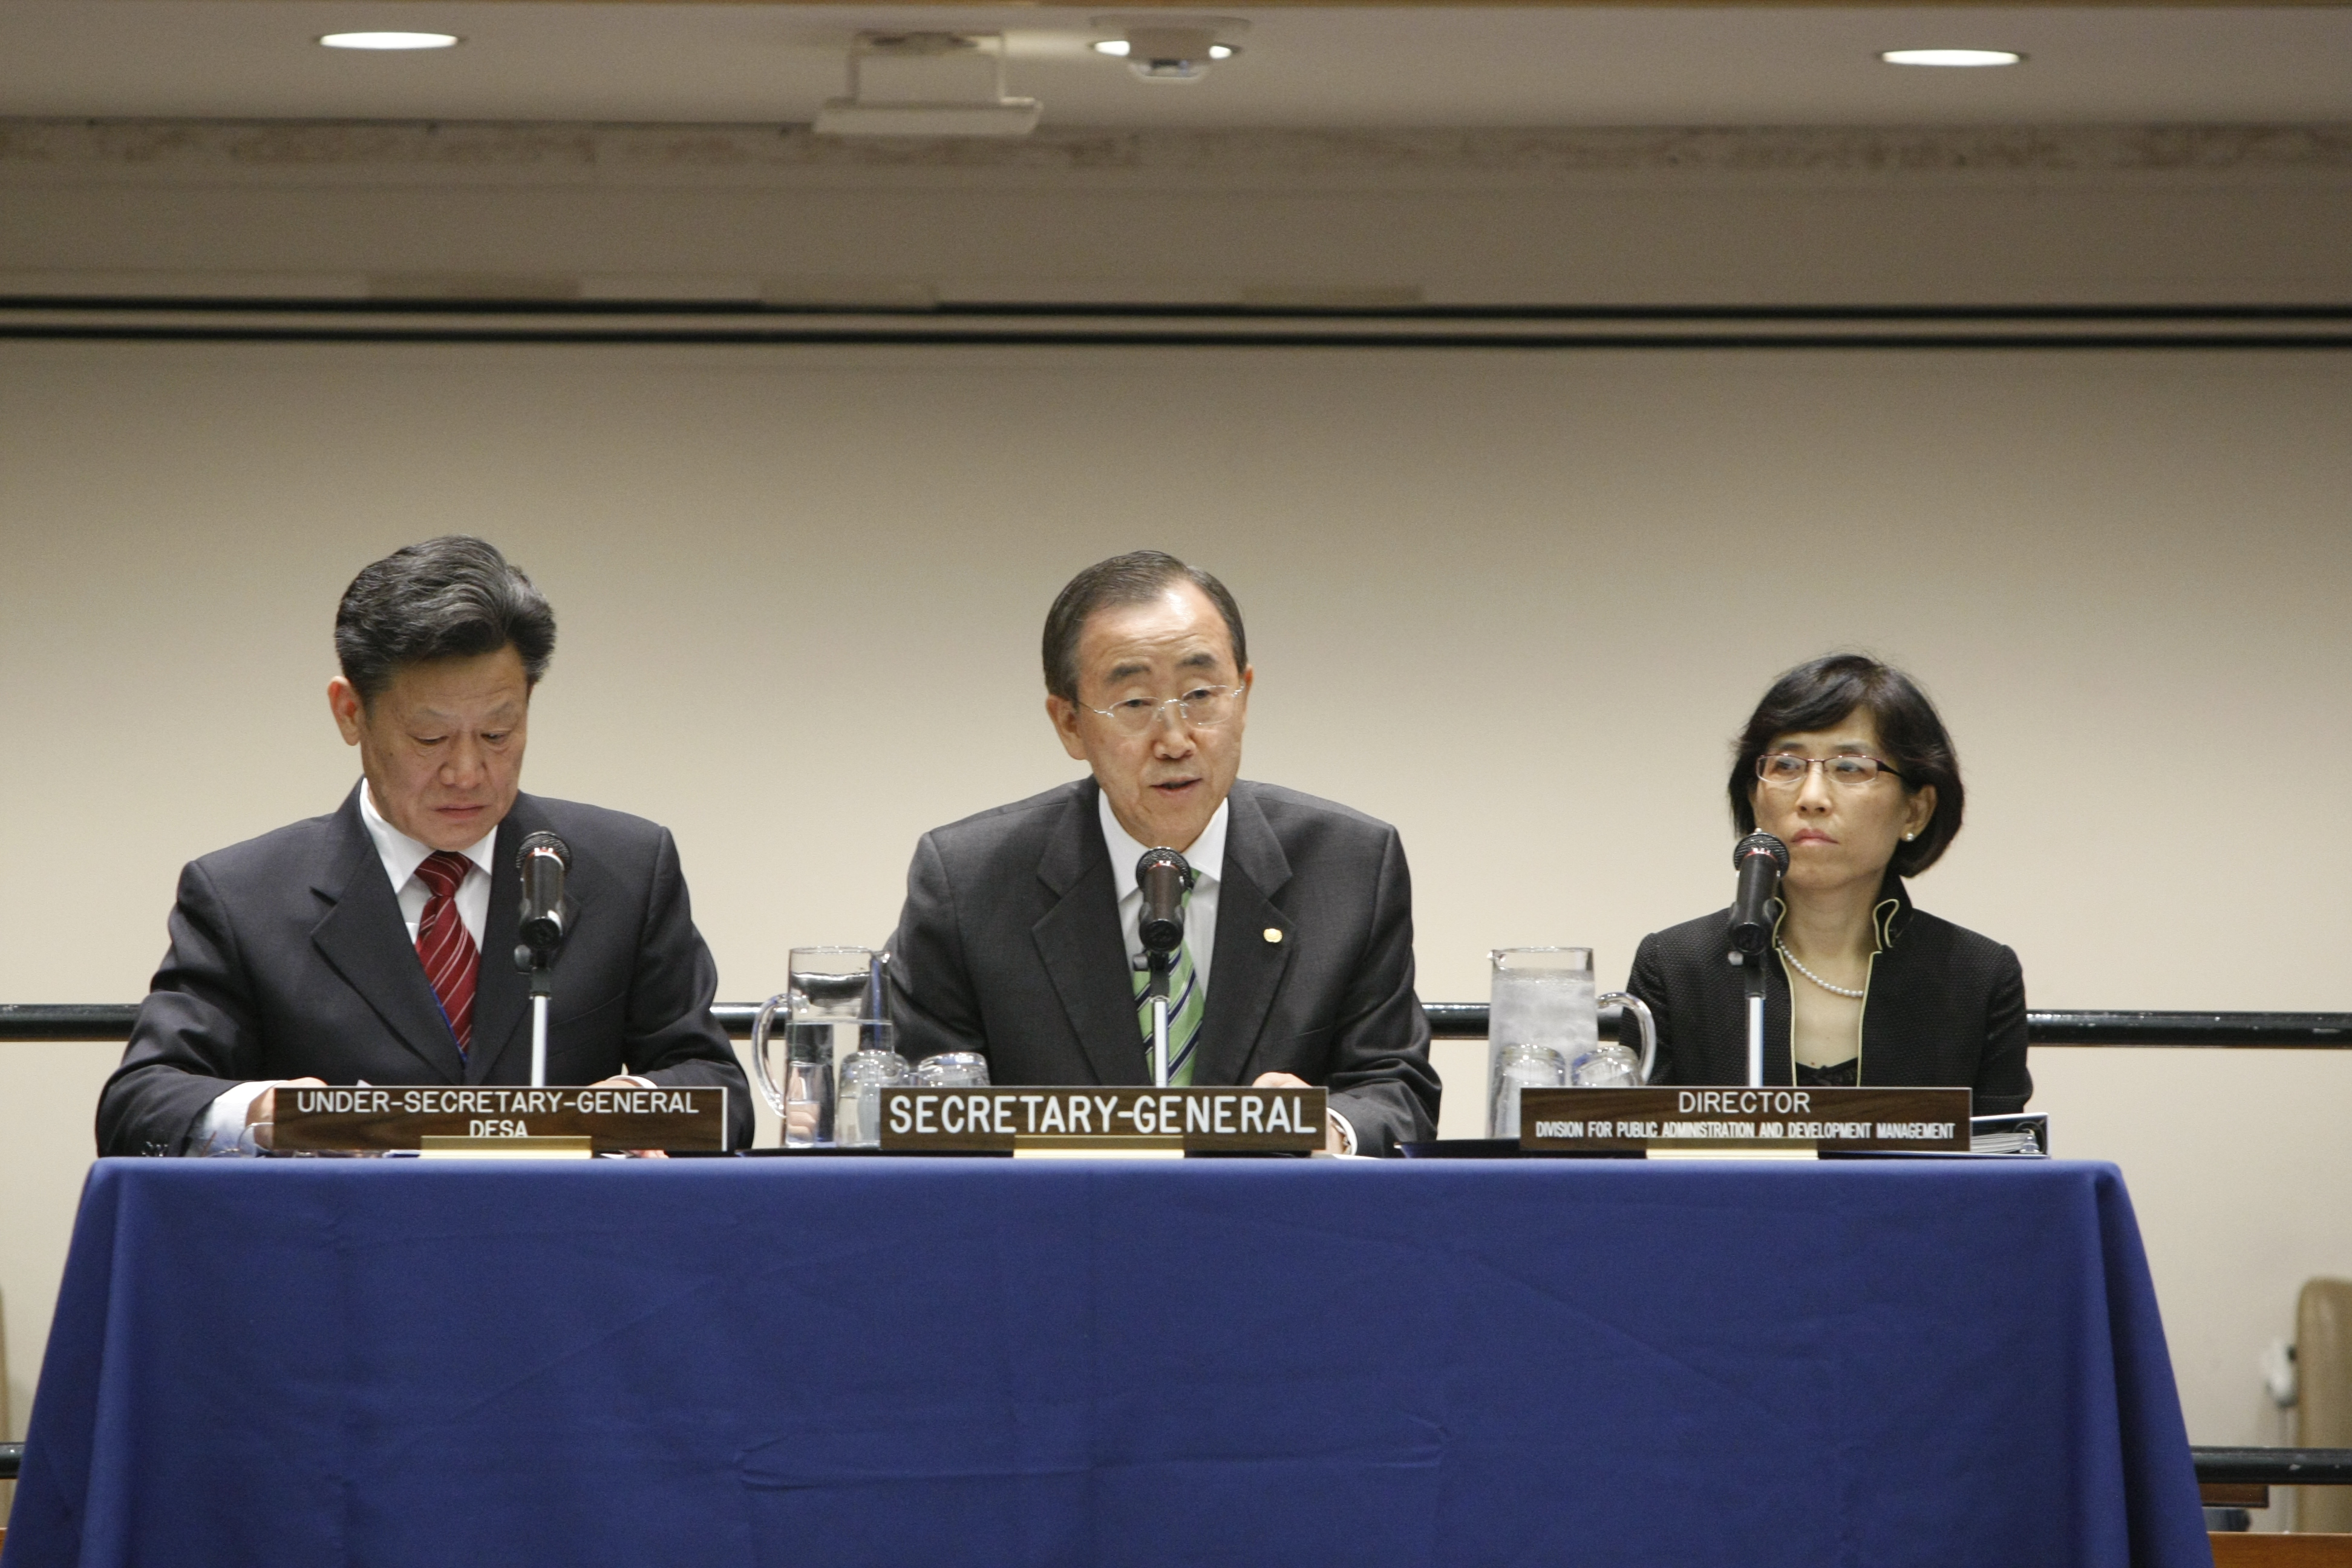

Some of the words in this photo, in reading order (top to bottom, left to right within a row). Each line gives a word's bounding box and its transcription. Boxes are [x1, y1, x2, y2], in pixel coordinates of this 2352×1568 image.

[296, 1091, 699, 1113] UNDER-SECRETARY-GENERAL
[1678, 1091, 1811, 1114] DIRECTOR
[889, 1096, 1317, 1134] SECRETARY-GENERAL
[469, 1120, 529, 1137] DESA
[1535, 1121, 1584, 1138] DIVISION
[1587, 1121, 1613, 1138] FOR
[1616, 1122, 1658, 1138] PUBLIC
[1662, 1122, 1756, 1138] ADMINISTRATION
[1758, 1122, 1784, 1138] AND
[1788, 1122, 1872, 1138] DEVELOPMENT
[1877, 1123, 1956, 1138] MANAGEMENT
